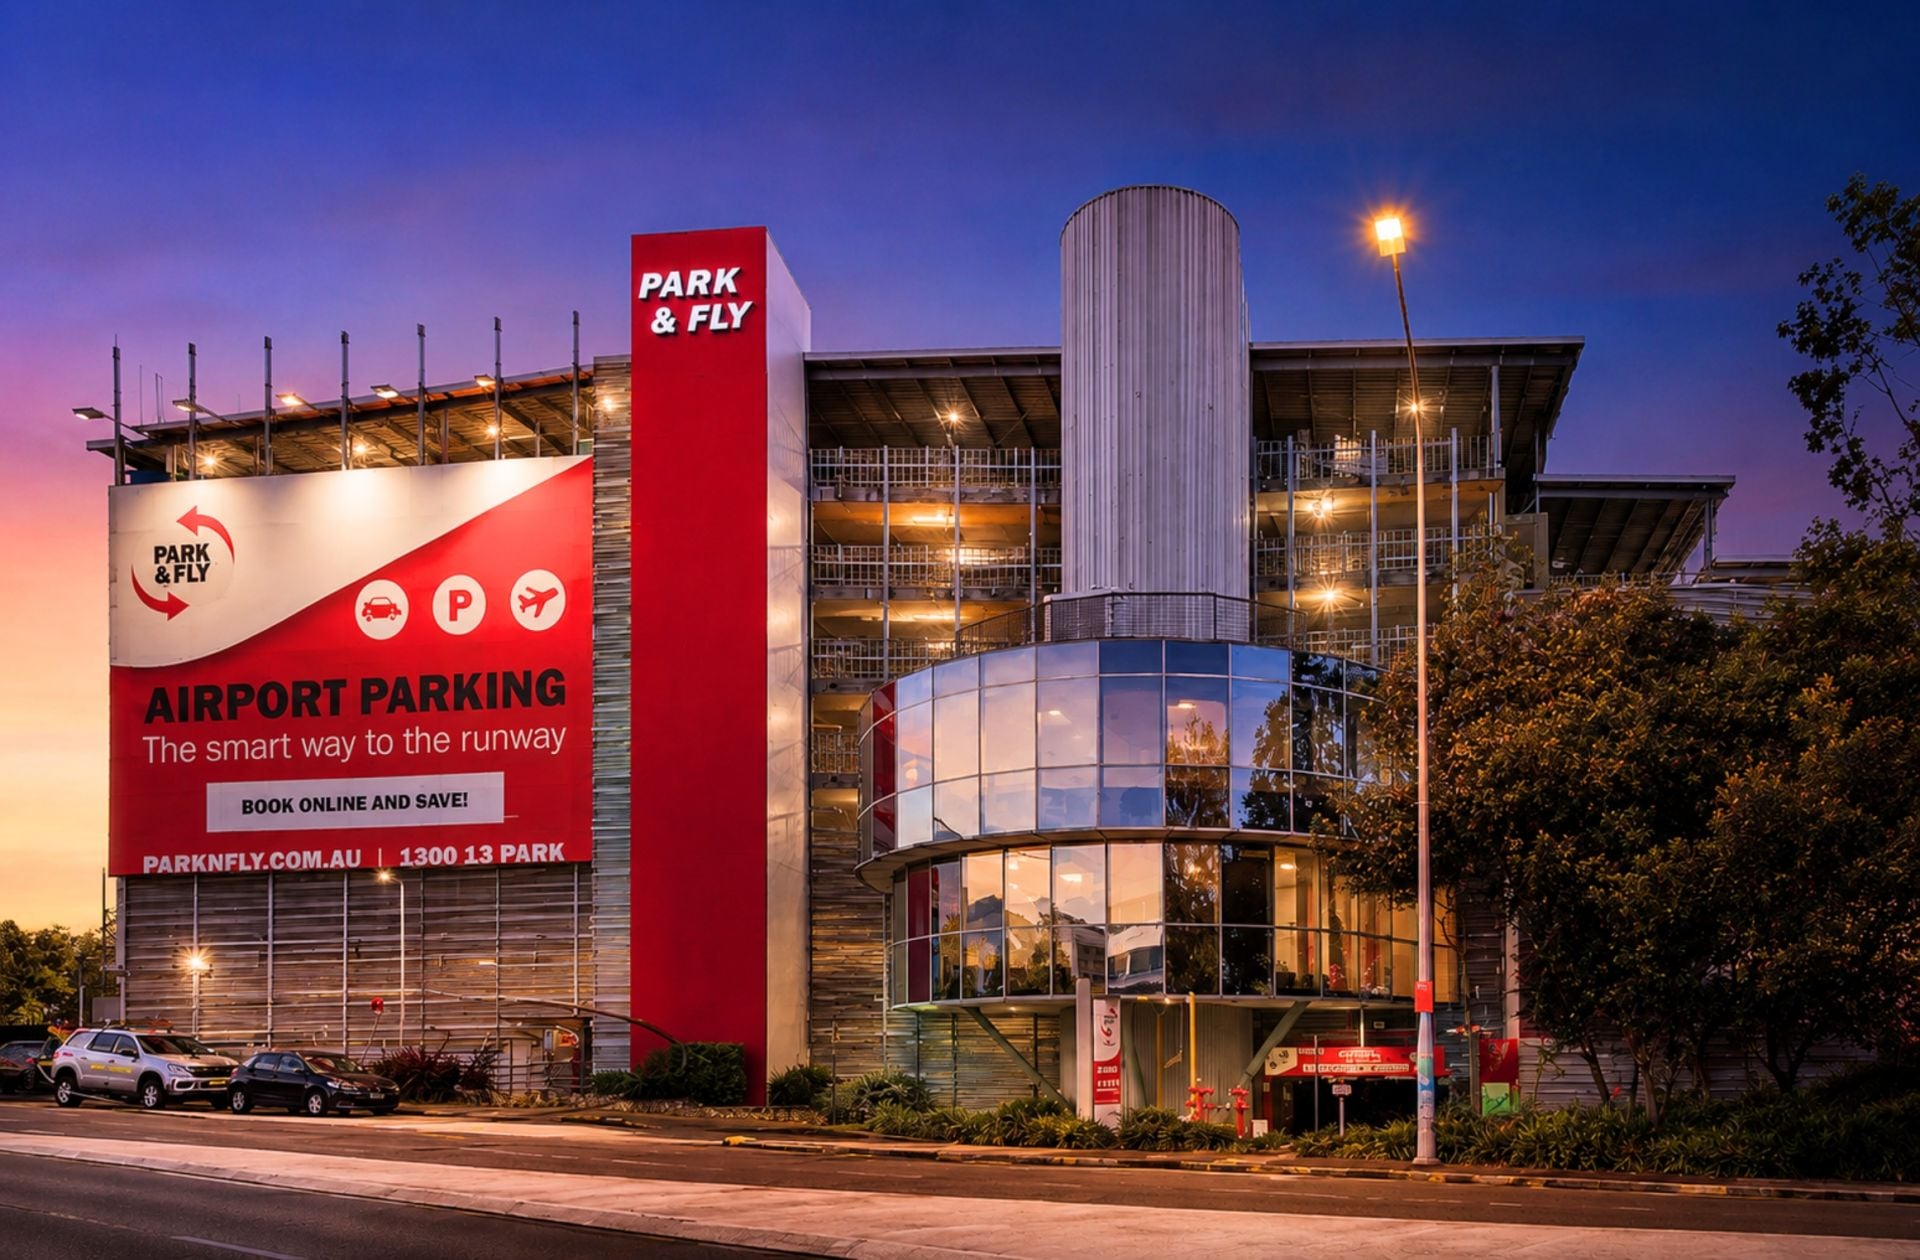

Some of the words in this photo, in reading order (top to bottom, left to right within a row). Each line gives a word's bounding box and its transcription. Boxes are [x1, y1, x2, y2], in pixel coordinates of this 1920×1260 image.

[638, 267, 741, 300] PARK
[650, 306, 678, 335] &
[687, 301, 753, 333] FLY
[153, 543, 211, 565] PARK
[154, 565, 172, 585] &
[173, 562, 211, 584] FLY
[449, 589, 473, 622] P
[144, 678, 348, 725] AIRPORT
[360, 668, 567, 715] PARKING
[142, 735, 197, 764] The
[205, 733, 292, 762] smart
[301, 735, 357, 764] way
[364, 729, 394, 756] to
[402, 726, 451, 755] the
[461, 727, 567, 755] runway
[241, 797, 295, 816] BOOK
[298, 795, 368, 813] ONLINE
[371, 793, 411, 811] AND
[415, 792, 469, 809] SAVE!
[143, 849, 362, 875] PARKNFLY.COM.AU
[400, 846, 458, 867] 1300
[464, 845, 493, 865] 13
[500, 842, 566, 864] PARK
